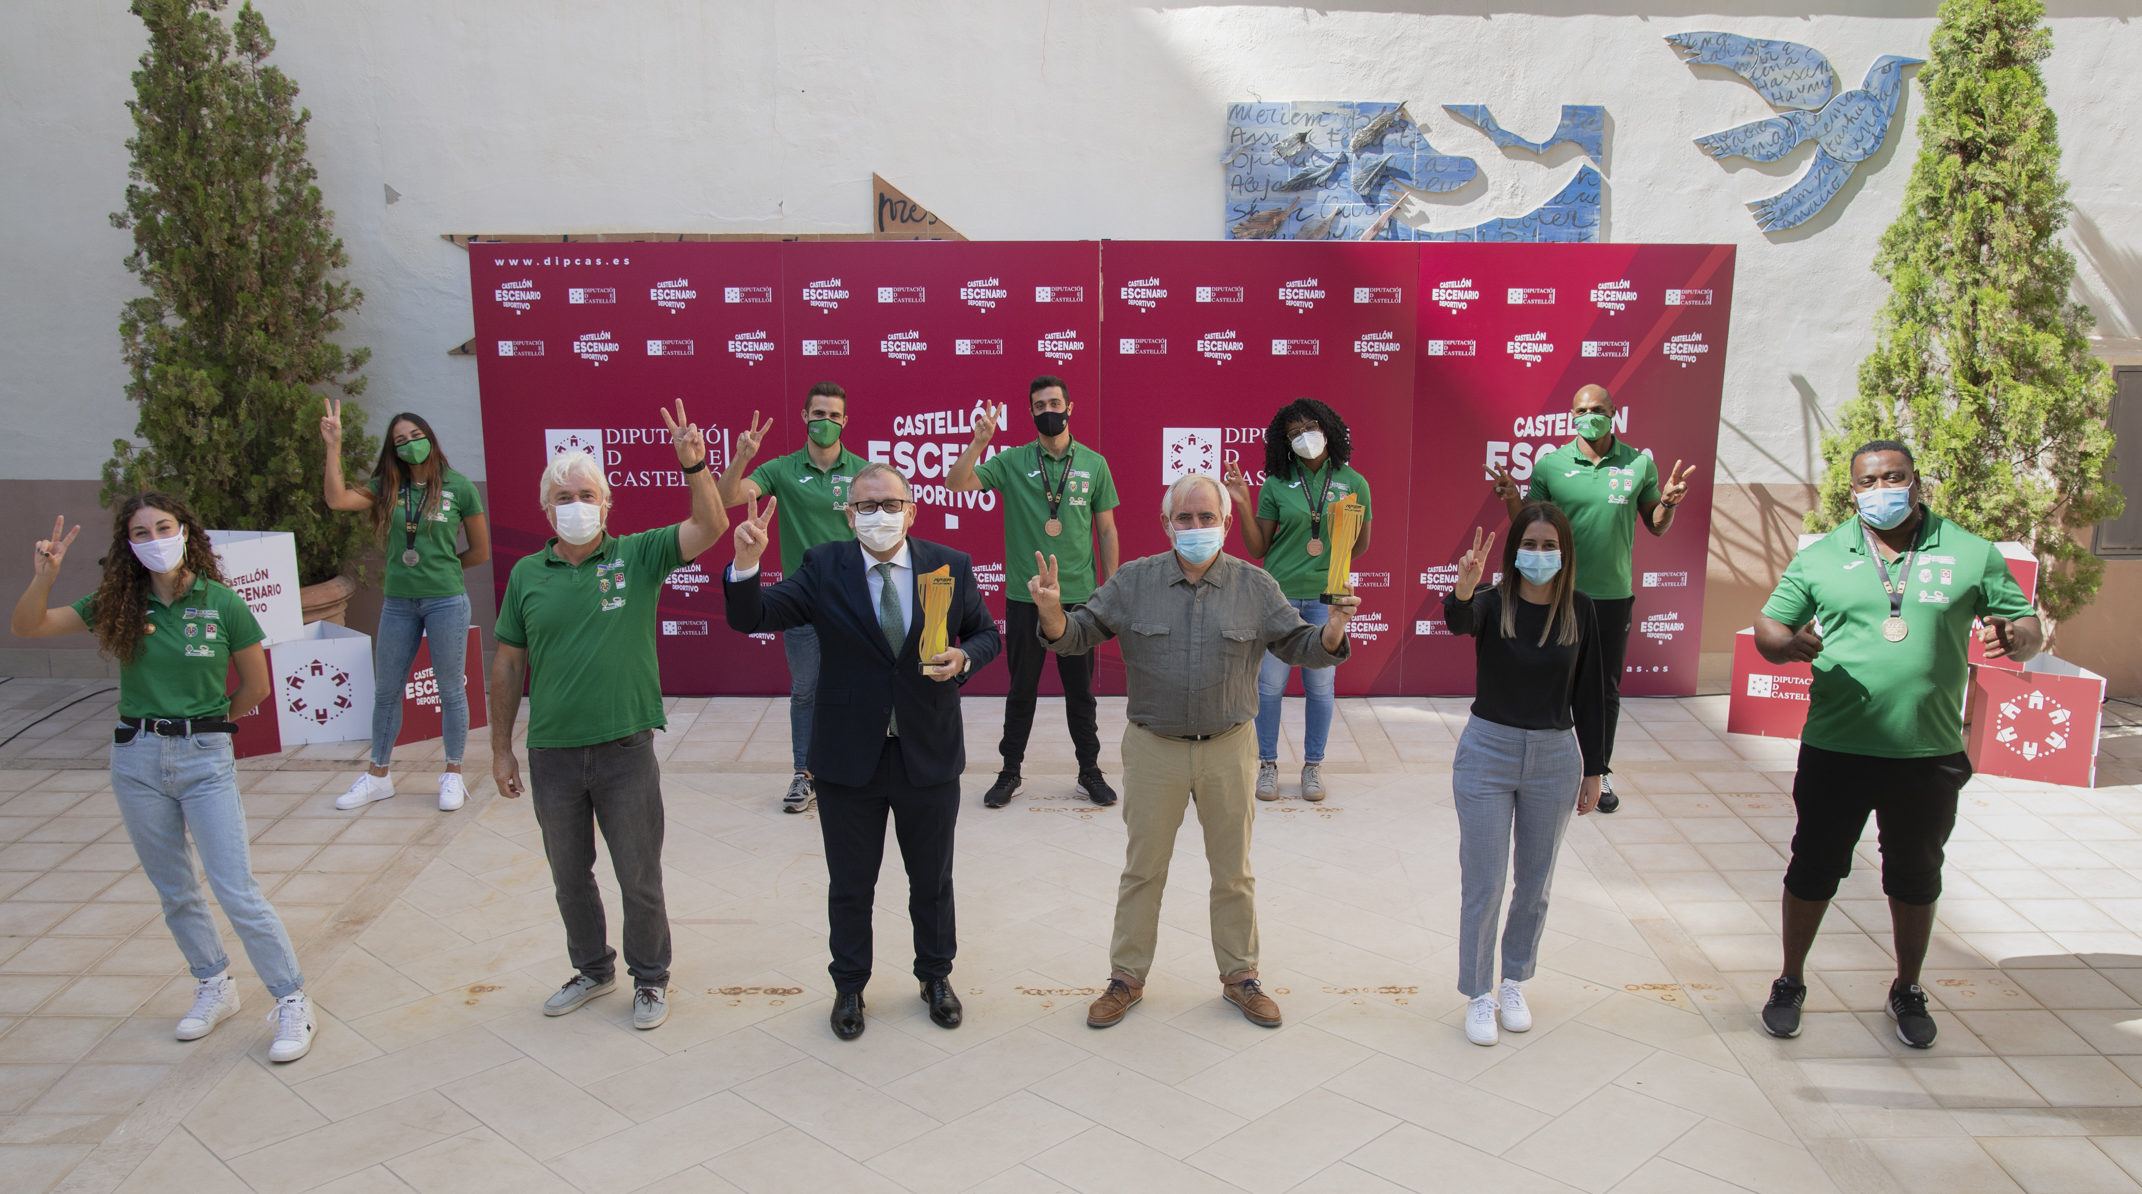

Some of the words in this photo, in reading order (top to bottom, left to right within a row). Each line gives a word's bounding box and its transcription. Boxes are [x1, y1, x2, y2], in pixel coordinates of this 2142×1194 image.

[495, 256, 630, 267] www.dipcas.es
[502, 279, 533, 289] CASTELLÓN
[657, 278, 688, 288] CASTELLÓN
[810, 278, 841, 288] CASTELLÓN
[968, 277, 999, 287] CASTELLÓN
[1128, 277, 1159, 287] CASTELLÓN
[1286, 277, 1317, 288] CASTELLÓN
[1439, 278, 1472, 288] CASTELLÓN
[1597, 279, 1630, 290] CASTELLÓN
[495, 289, 541, 302] ESCENARIO
[650, 288, 696, 301] ESCENARIO
[803, 288, 849, 301] ESCENARIO
[961, 287, 1007, 300] ESCENARIO
[1121, 287, 1167, 300] ESCENARIO
[1279, 287, 1325, 301] ESCENARIO
[1432, 288, 1479, 301] ESCENARIO
[1590, 289, 1637, 303] ESCENARIO
[581, 330, 611, 340] CASTELLÓN
[735, 330, 766, 340] CASTELLÓN
[888, 330, 919, 340] CASTELLÓN
[1045, 329, 1076, 339] CASTELLÓN
[1204, 330, 1235, 340] CASTELLÓN
[1361, 330, 1392, 340] CASTELLÓN
[1514, 331, 1546, 341] CASTELLÓN
[1670, 332, 1701, 342] CASTELLÓN
[574, 340, 619, 353] ESCENARIO
[728, 340, 774, 353] ESCENARIO
[881, 340, 927, 353] ESCENARIO
[1038, 339, 1084, 352] ESCENARIO
[1197, 340, 1243, 352] ESCENARIO
[1354, 340, 1400, 353] ESCENARIO
[1507, 341, 1553, 354] ESCENARIO
[1663, 342, 1708, 355] ESCENARIO
[1514, 407, 1629, 437] CASTELN
[607, 450, 622, 465] D
[709, 450, 722, 465] E
[1428, 563, 1458, 573] CASTELLÓN
[1420, 573, 1459, 584] ESCENAR
[1648, 611, 1678, 621] CASTELLÓN
[1640, 622, 1684, 632] ESCENARIO
